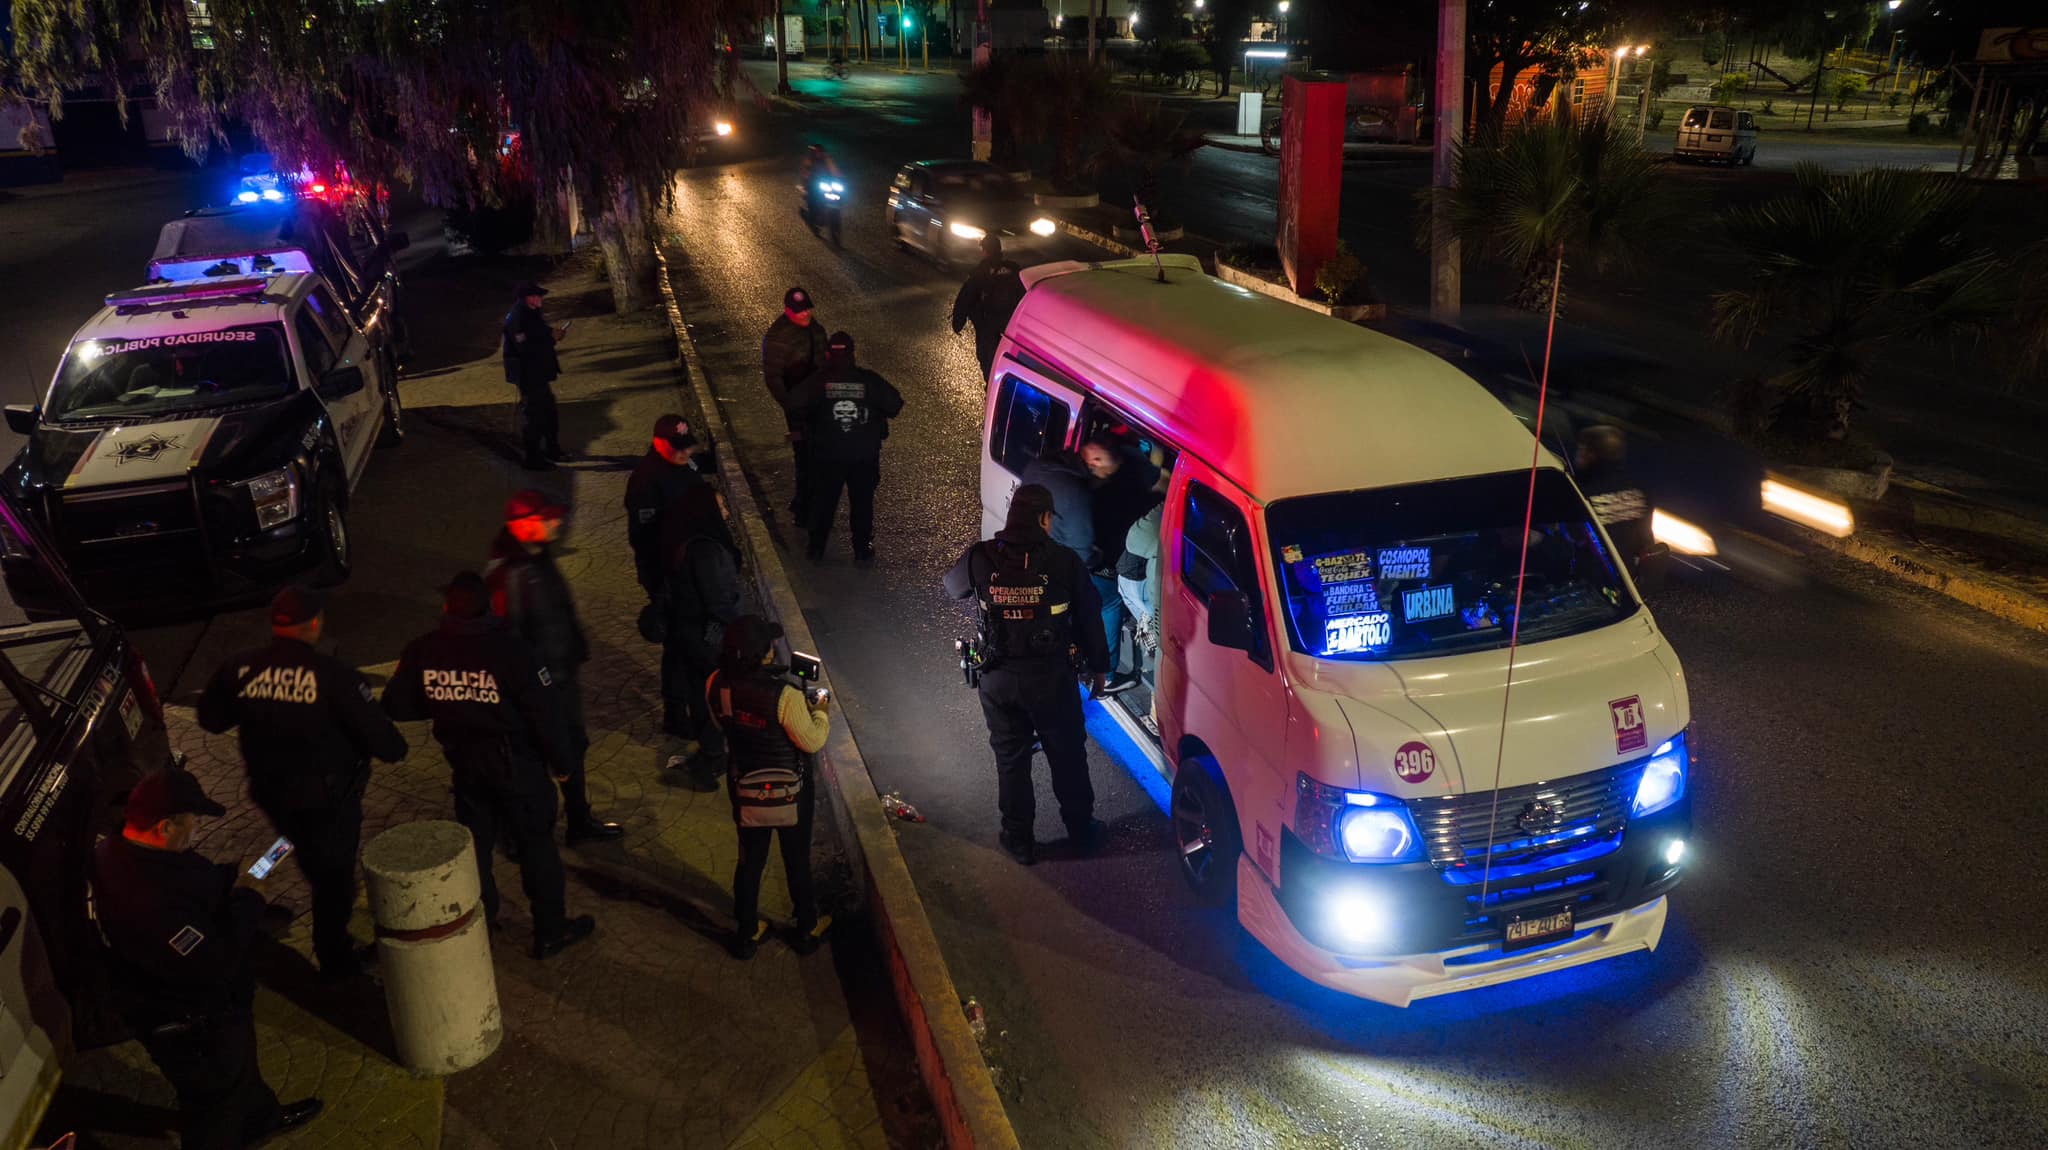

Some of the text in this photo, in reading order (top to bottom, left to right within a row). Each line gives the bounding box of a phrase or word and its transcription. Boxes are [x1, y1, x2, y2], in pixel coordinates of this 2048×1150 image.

[1380, 549, 1430, 565] COSMOPOL
[1381, 563, 1430, 579] FUENTES
[989, 585, 1044, 596] OPERACIONES
[1329, 584, 1364, 596] BANDERA
[993, 594, 1041, 604] ESPECIALES
[1326, 592, 1376, 605] FUENTES
[1406, 587, 1454, 621] URBINA
[1328, 601, 1378, 614] CHILPAN
[1327, 613, 1389, 630] MERCADO
[423, 669, 498, 690] POLICÍA
[424, 686, 501, 705] COACALCO
[1396, 749, 1434, 776] 396
